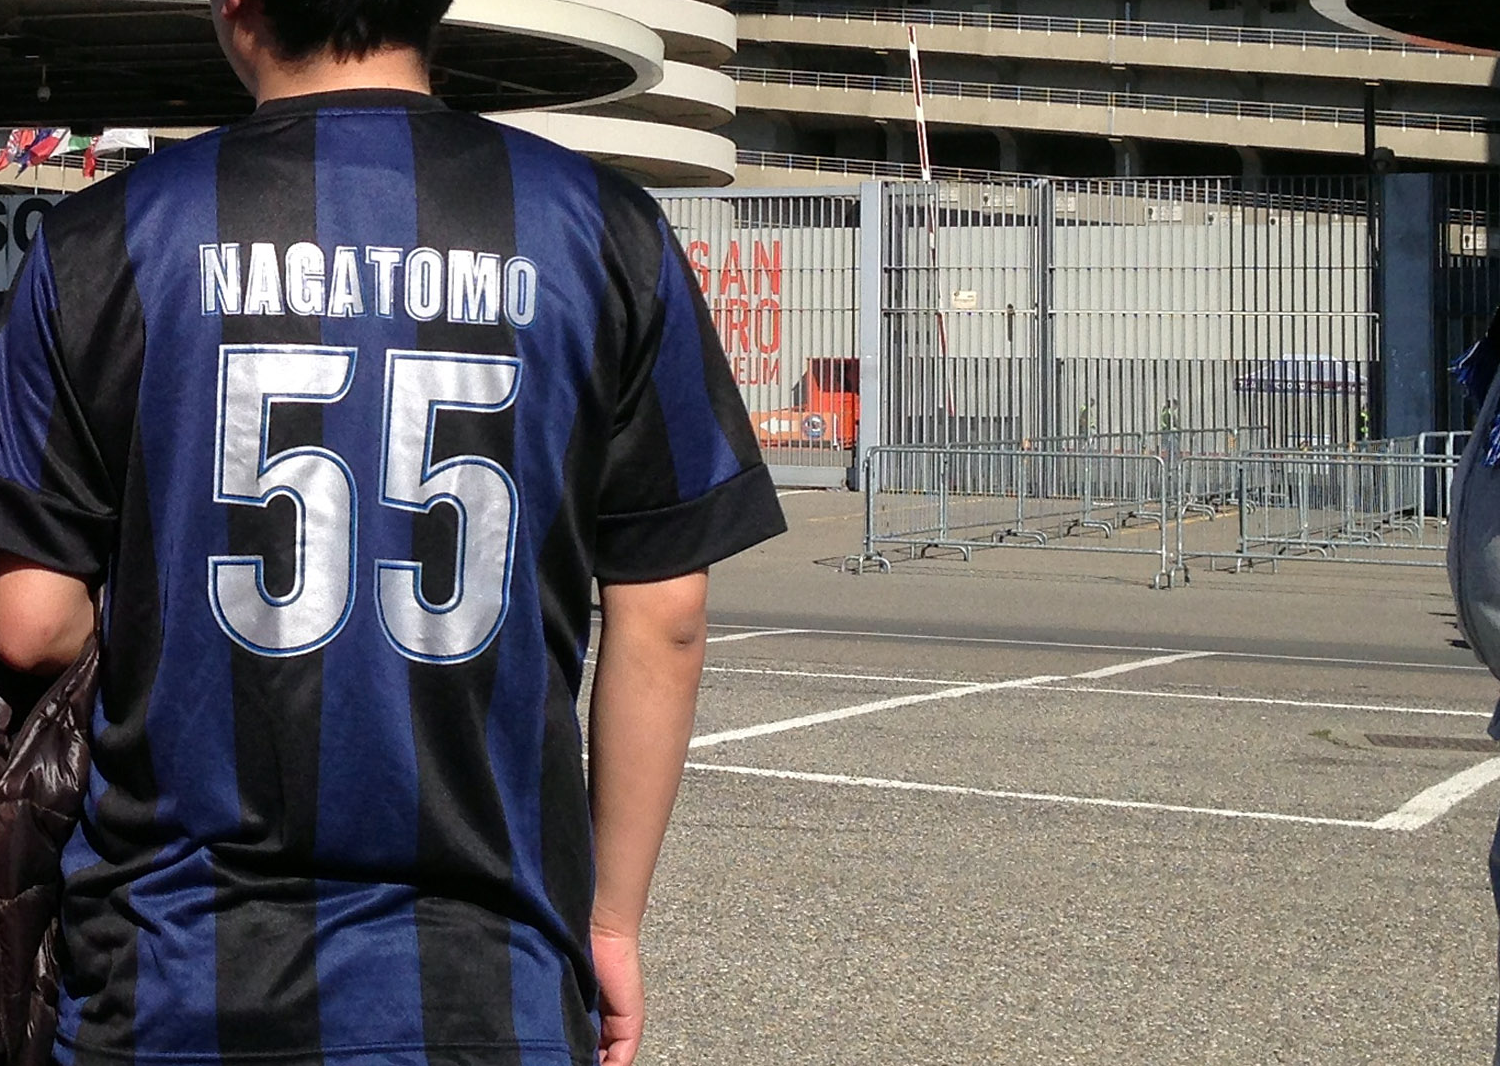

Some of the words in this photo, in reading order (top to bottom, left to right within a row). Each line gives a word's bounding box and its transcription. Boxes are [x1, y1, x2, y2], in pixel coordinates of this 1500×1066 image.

[198, 242, 539, 329] NAGATOMO
[687, 239, 781, 295] SAN
[206, 343, 523, 665] 55
